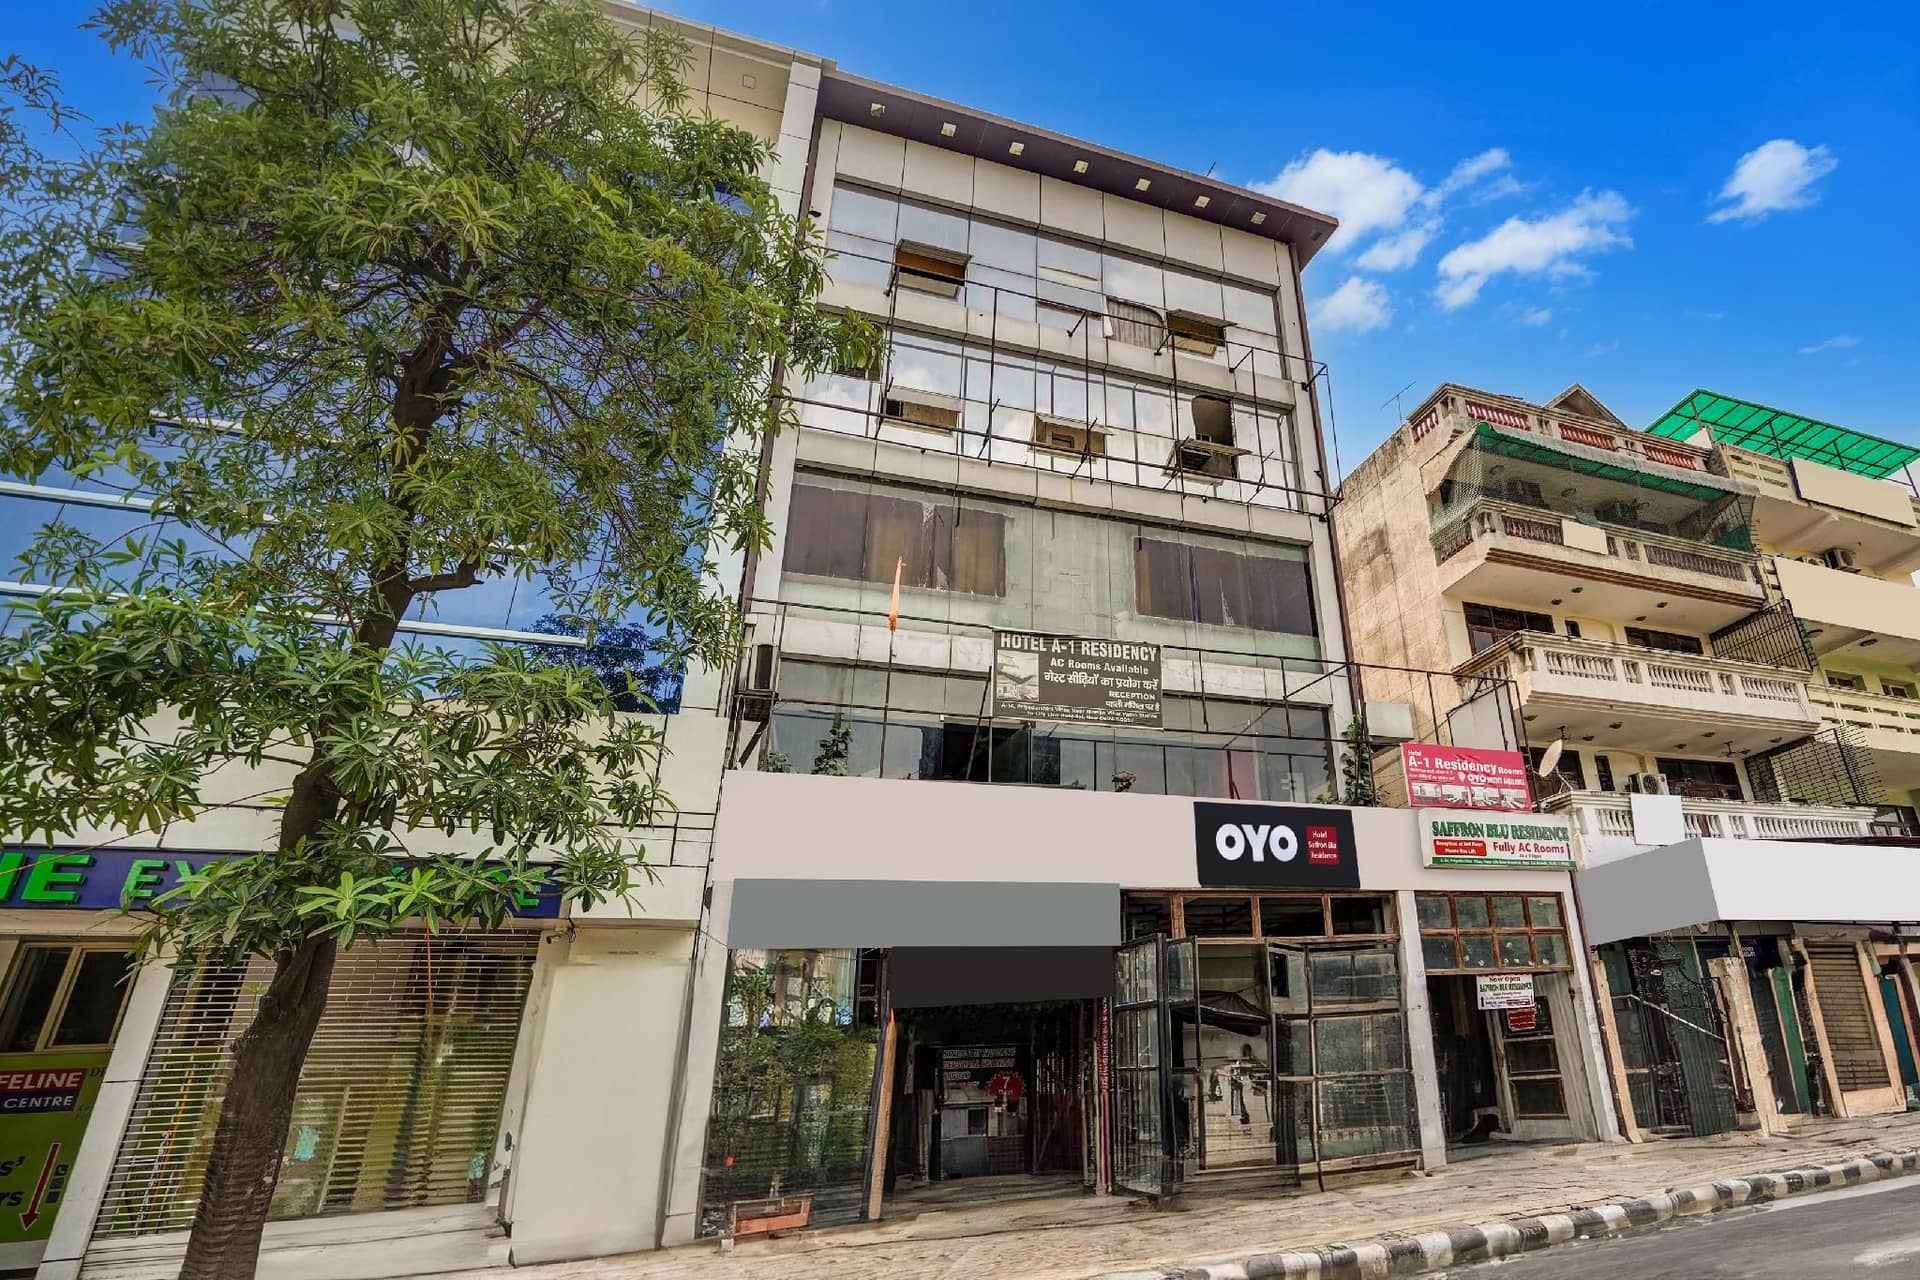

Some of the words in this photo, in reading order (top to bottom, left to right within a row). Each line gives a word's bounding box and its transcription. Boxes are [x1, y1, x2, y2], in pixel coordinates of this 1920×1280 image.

[1000, 632, 1047, 652] HOTEL
[1051, 638, 1075, 655] A-1
[1081, 640, 1157, 662] RESIDENCY
[1050, 657, 1065, 668] AC
[1068, 659, 1101, 671] Rooms
[1103, 662, 1149, 675] Available
[1100, 677, 1114, 687] का
[1115, 676, 1141, 689] प्रयोग
[1142, 678, 1159, 690] करें
[1108, 690, 1156, 701] RECEPTION
[1408, 756, 1430, 768] A-1
[1434, 757, 1497, 775] Residency
[1497, 766, 1524, 775] Rooms
[1432, 821, 1485, 838] SAFFRON
[1486, 823, 1509, 839] BLU
[1511, 824, 1570, 841] RESIDENCE
[1215, 823, 1298, 863] OYO
[1492, 842, 1516, 855] Fully
[1518, 842, 1532, 853] AC
[1533, 843, 1565, 854] Rooms
[4, 1096, 74, 1109] CENTRE
